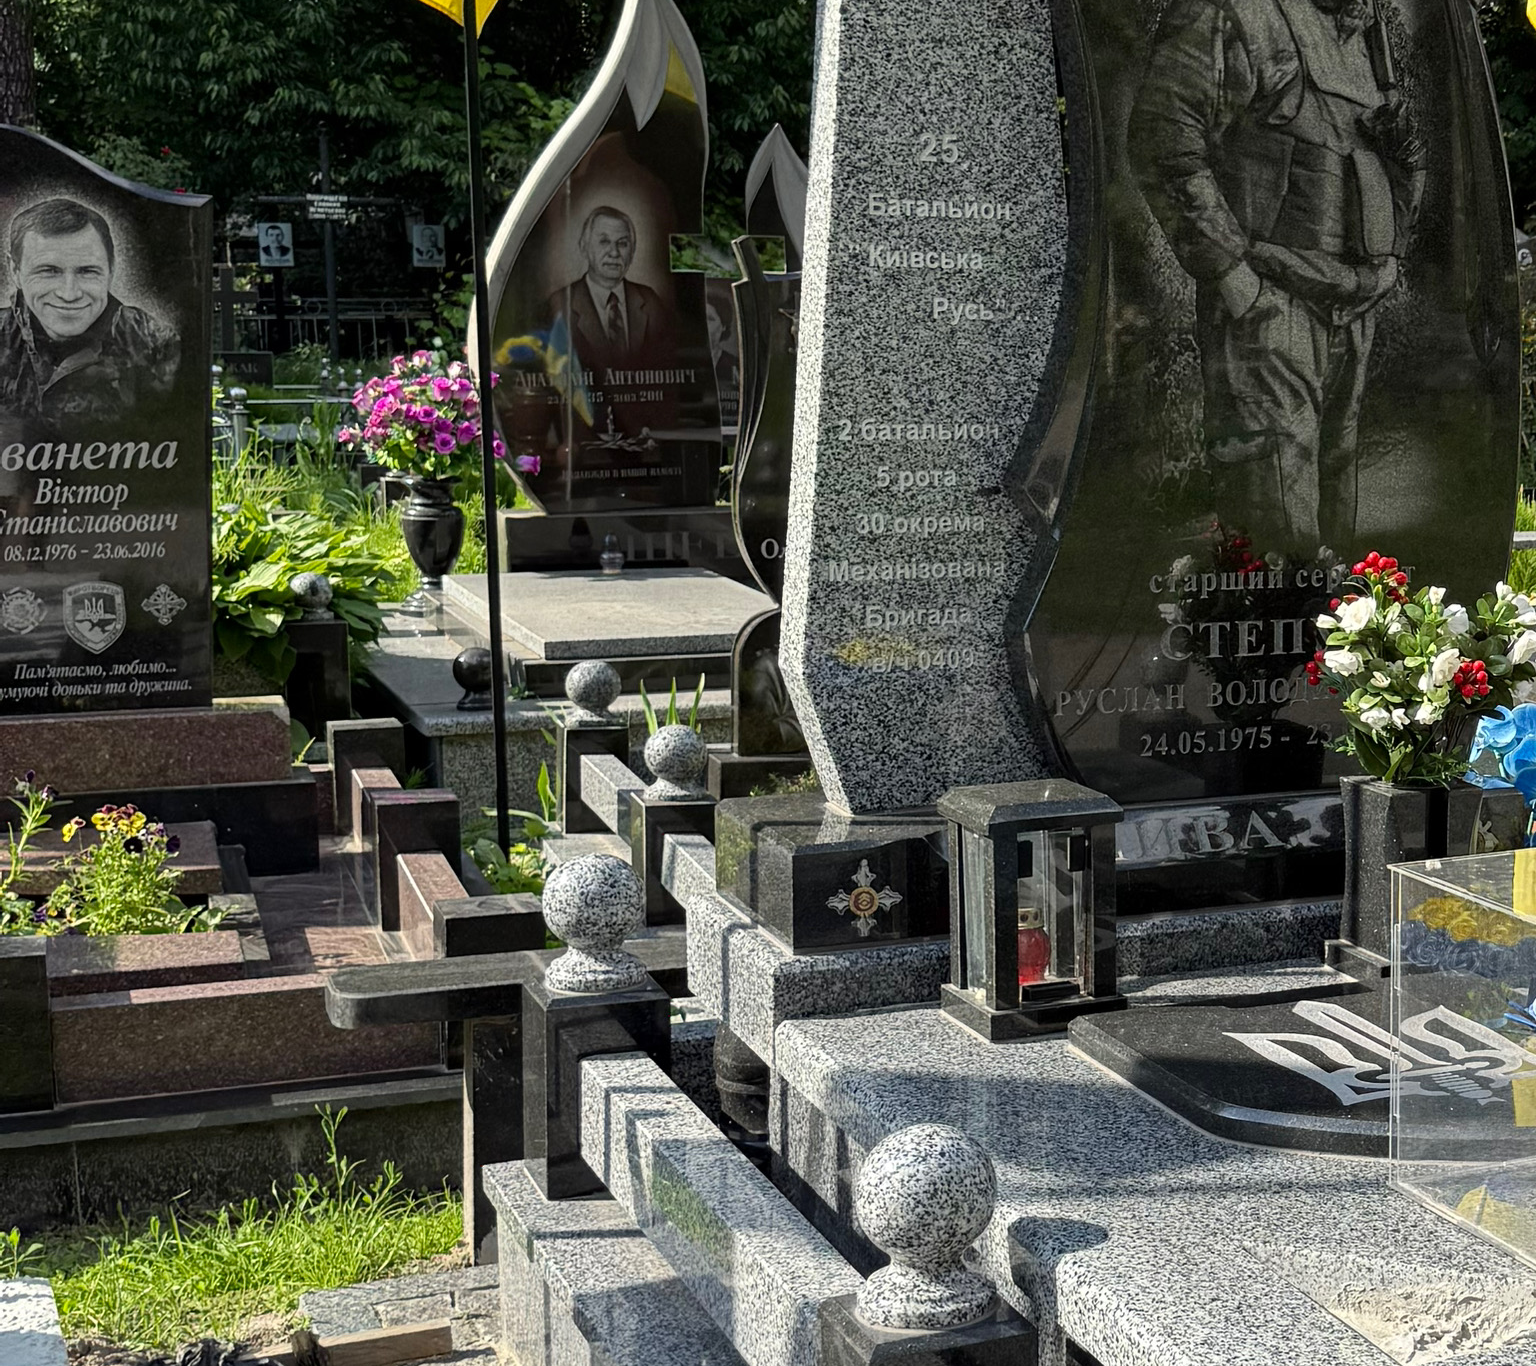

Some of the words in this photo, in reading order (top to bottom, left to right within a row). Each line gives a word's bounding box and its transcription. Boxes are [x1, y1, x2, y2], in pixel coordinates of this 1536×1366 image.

[920, 134, 959, 163] 25
[838, 419, 852, 441] 2
[1, 440, 178, 471] ванета
[876, 466, 890, 487] 5
[900, 469, 957, 492] рота
[34, 478, 129, 510] Віктор
[856, 511, 885, 535] 30
[894, 513, 986, 536] окрема
[4, 543, 77, 562] 08.12.1976
[92, 542, 166, 559] 23.06.2016
[828, 558, 1005, 582] Механізована
[1150, 568, 1283, 599] старший
[1296, 564, 1416, 593] серт
[865, 605, 973, 631] Бригада
[1161, 618, 1317, 661] СТЕП
[14, 663, 108, 680] Пам'ятаємо,
[52, 680, 101, 697] доньки
[105, 683, 128, 695] та
[128, 677, 192, 698] дружина.
[1054, 684, 1185, 717] РУСЛАН
[1140, 725, 1272, 757] 24.05.1975
